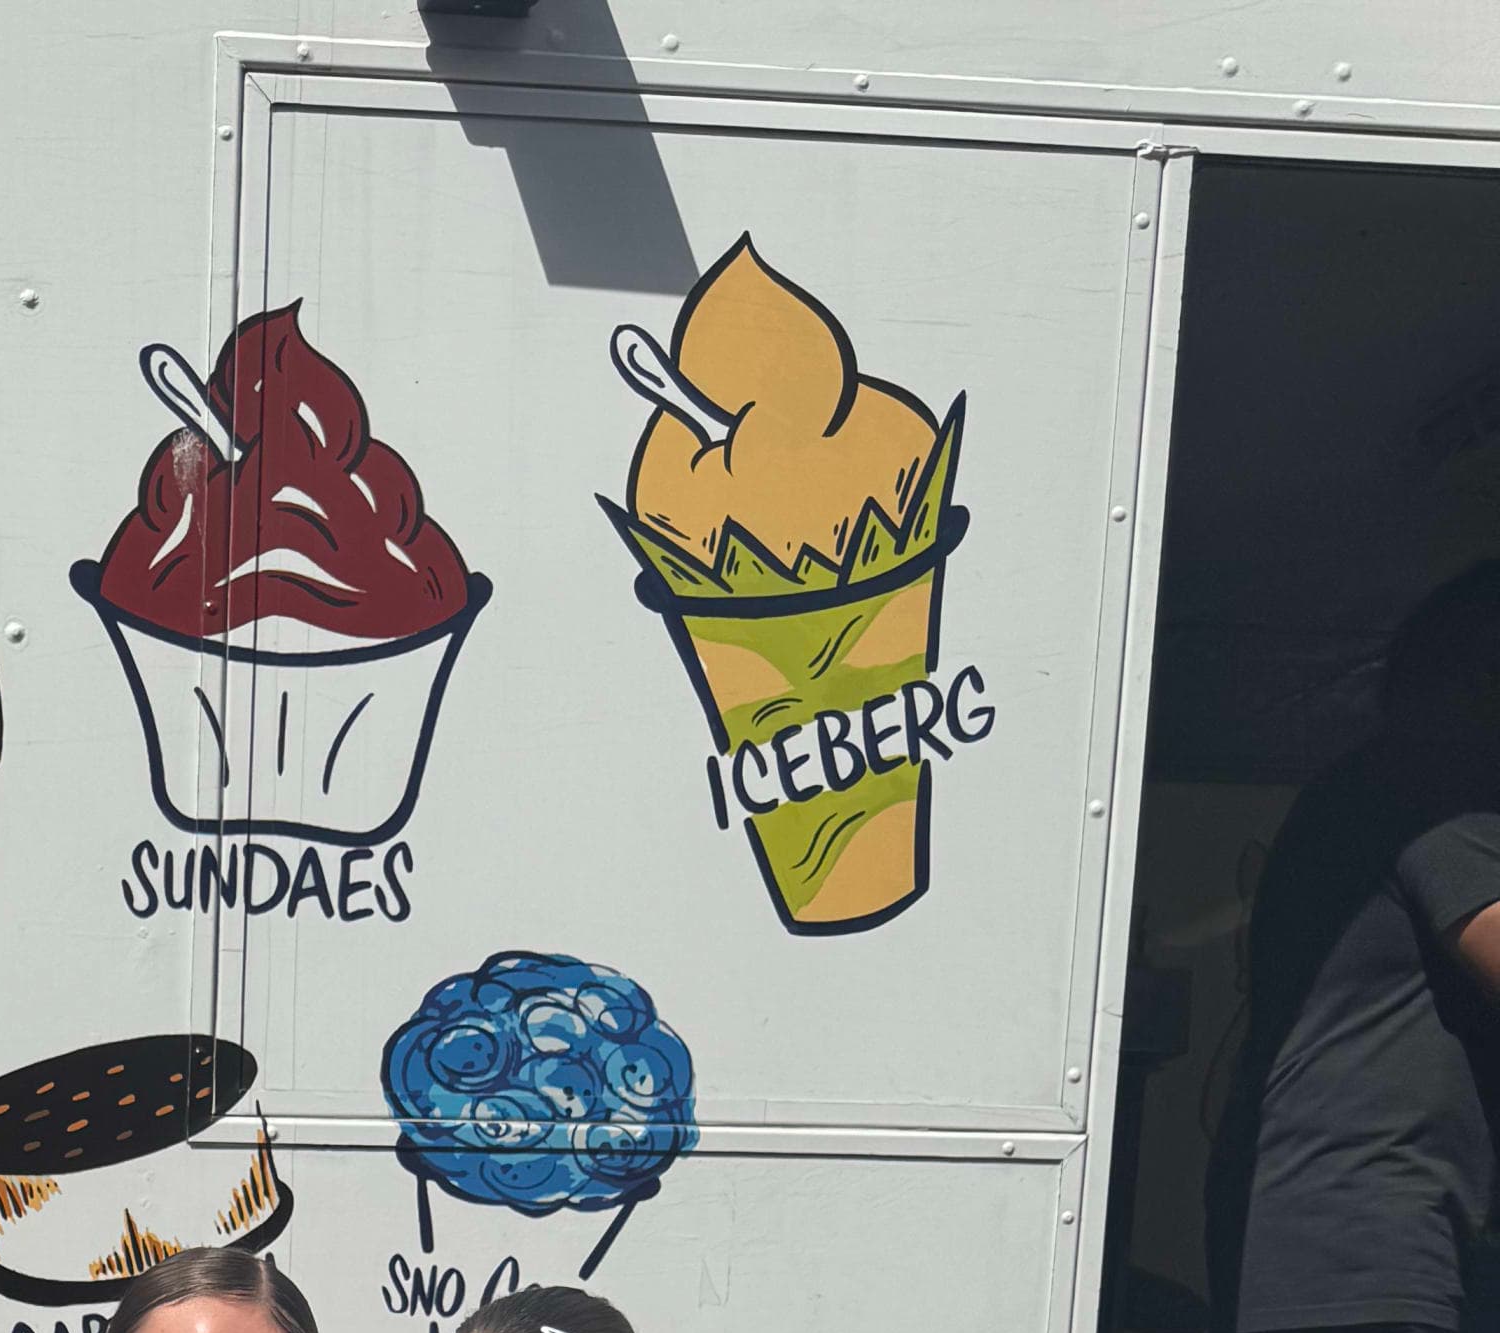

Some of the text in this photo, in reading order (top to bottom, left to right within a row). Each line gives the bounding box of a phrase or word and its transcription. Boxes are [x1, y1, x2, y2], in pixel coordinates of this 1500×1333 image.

[706, 665, 995, 830] ICEBERG
[121, 839, 414, 922] SUNDAES
[381, 1253, 466, 1318] SNO
